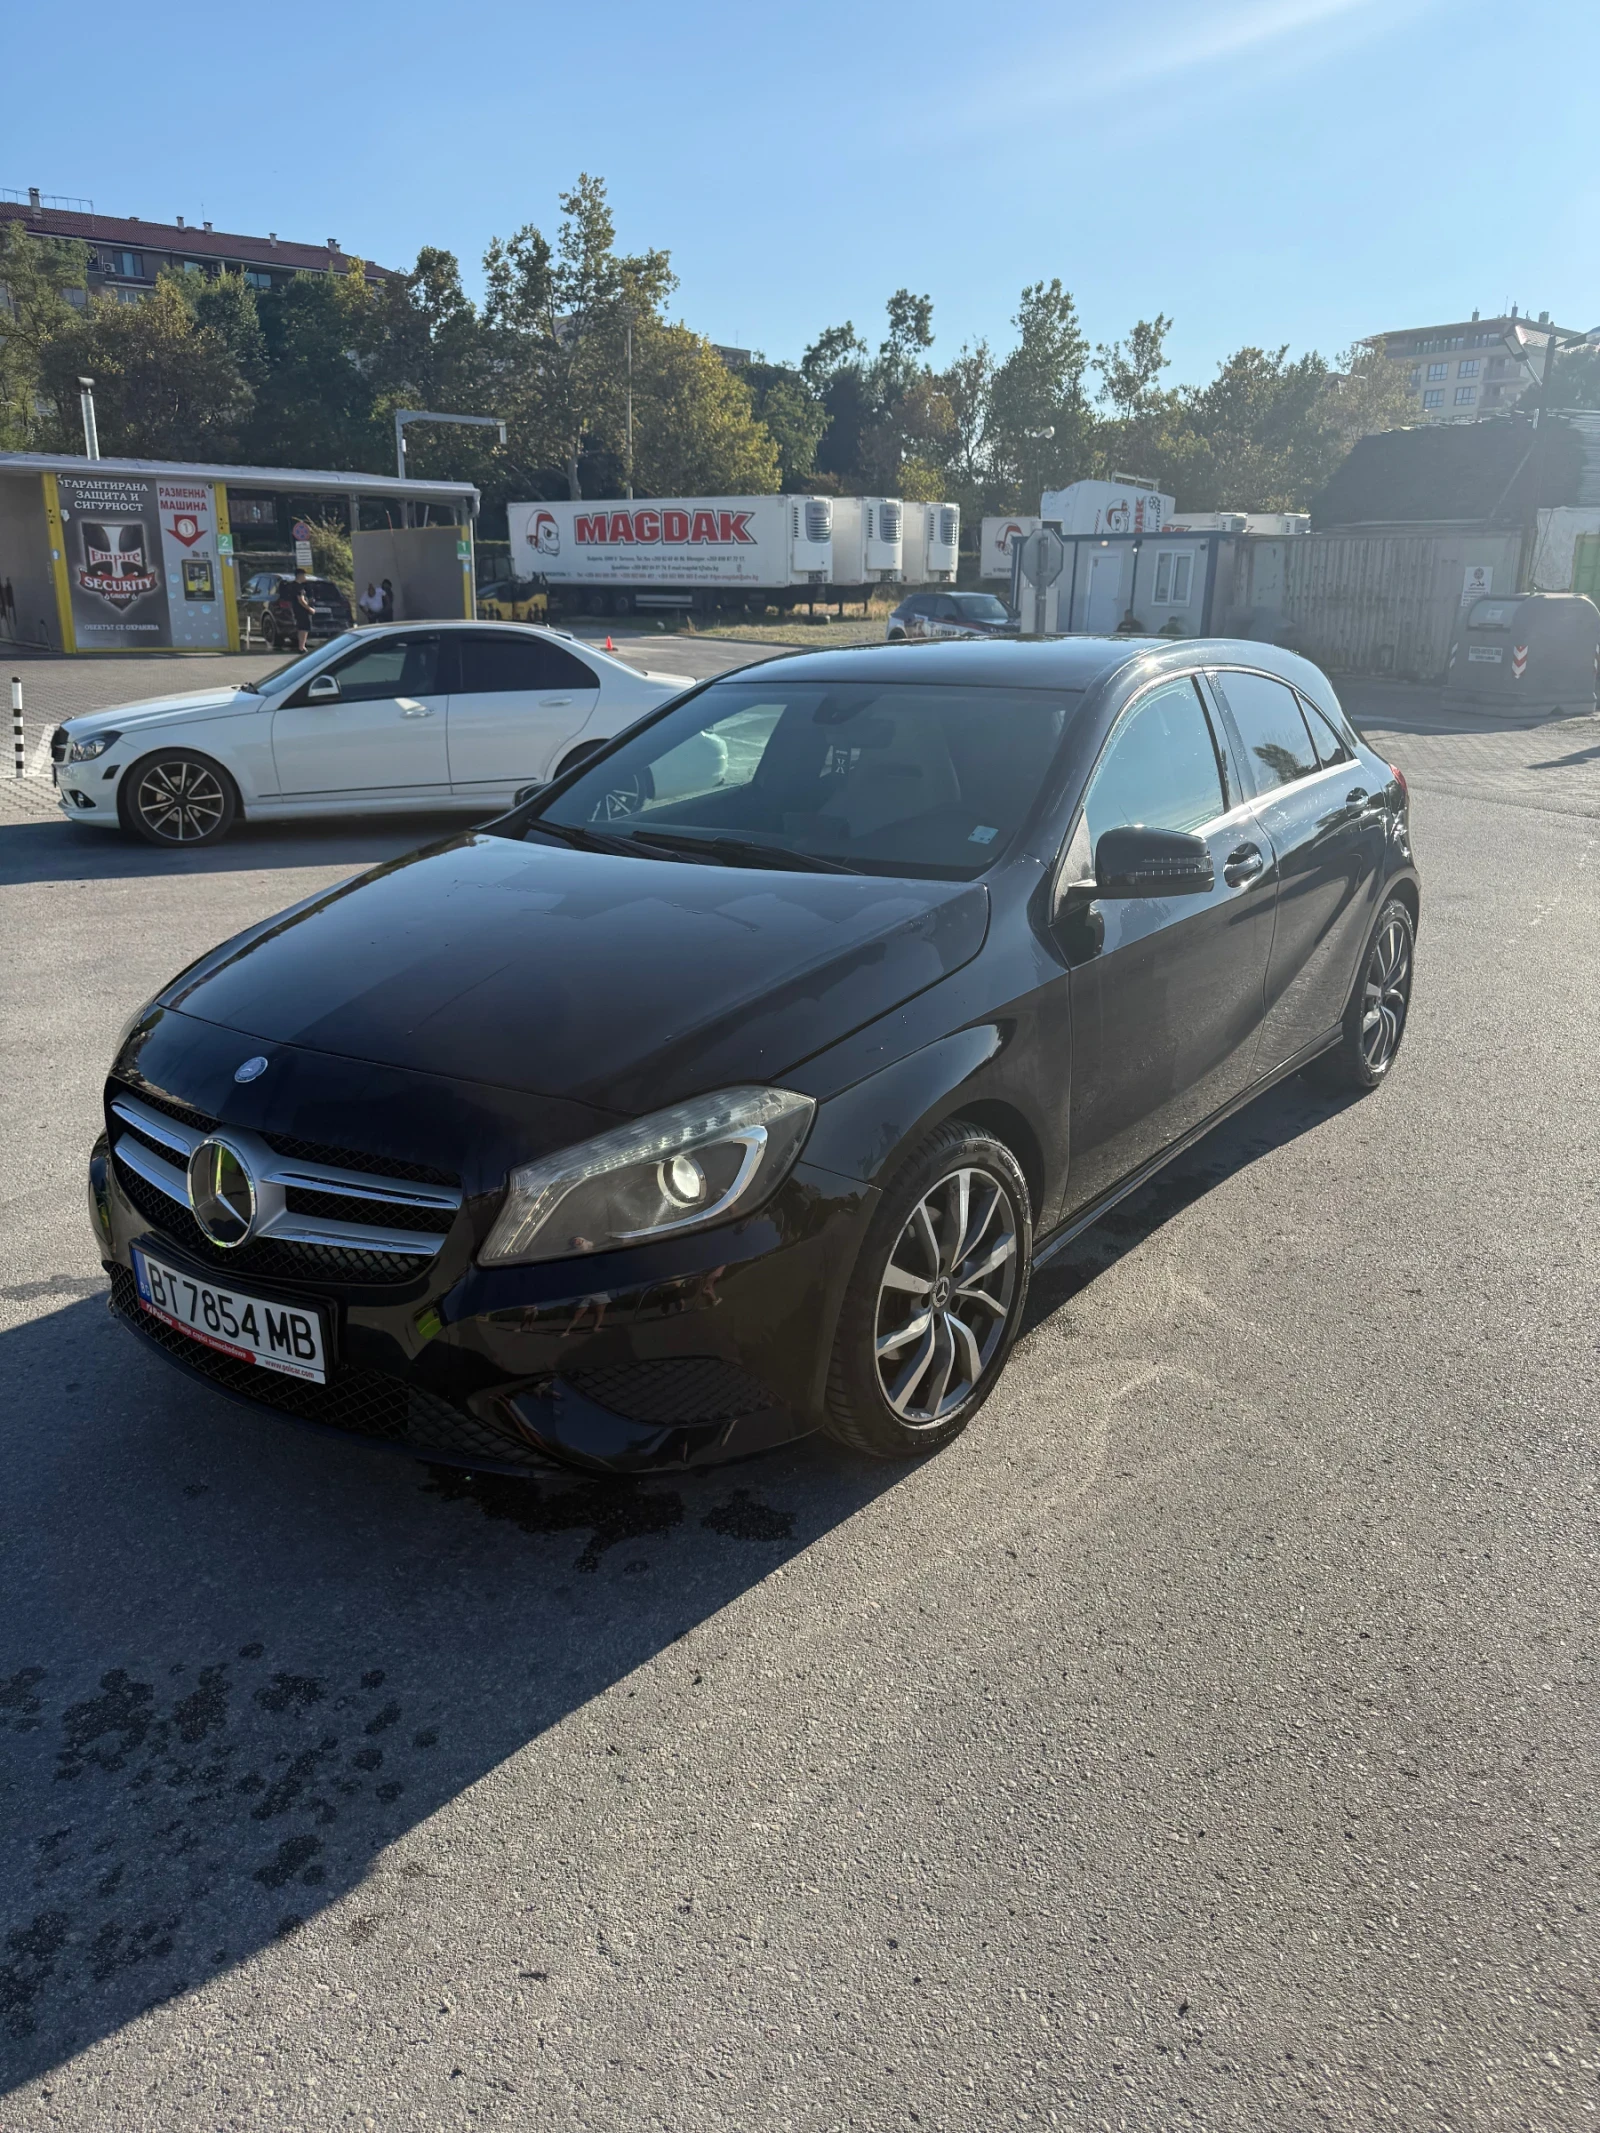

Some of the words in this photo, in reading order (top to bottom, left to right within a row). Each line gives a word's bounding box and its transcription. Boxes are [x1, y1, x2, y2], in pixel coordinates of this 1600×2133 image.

[64, 479, 149, 492] ГАРАНТИРАНА
[76, 490, 127, 501] ЗАЩИТА
[130, 493, 139, 501] И
[159, 487, 207, 498] РАЗМЕННА
[74, 500, 144, 512] СИГУРНОСТ
[160, 500, 208, 511] МАШИНА
[574, 509, 757, 545] MAGDAK
[221, 536, 229, 546] 2
[91, 550, 141, 572] Empire
[84, 576, 153, 591] SECURITY
